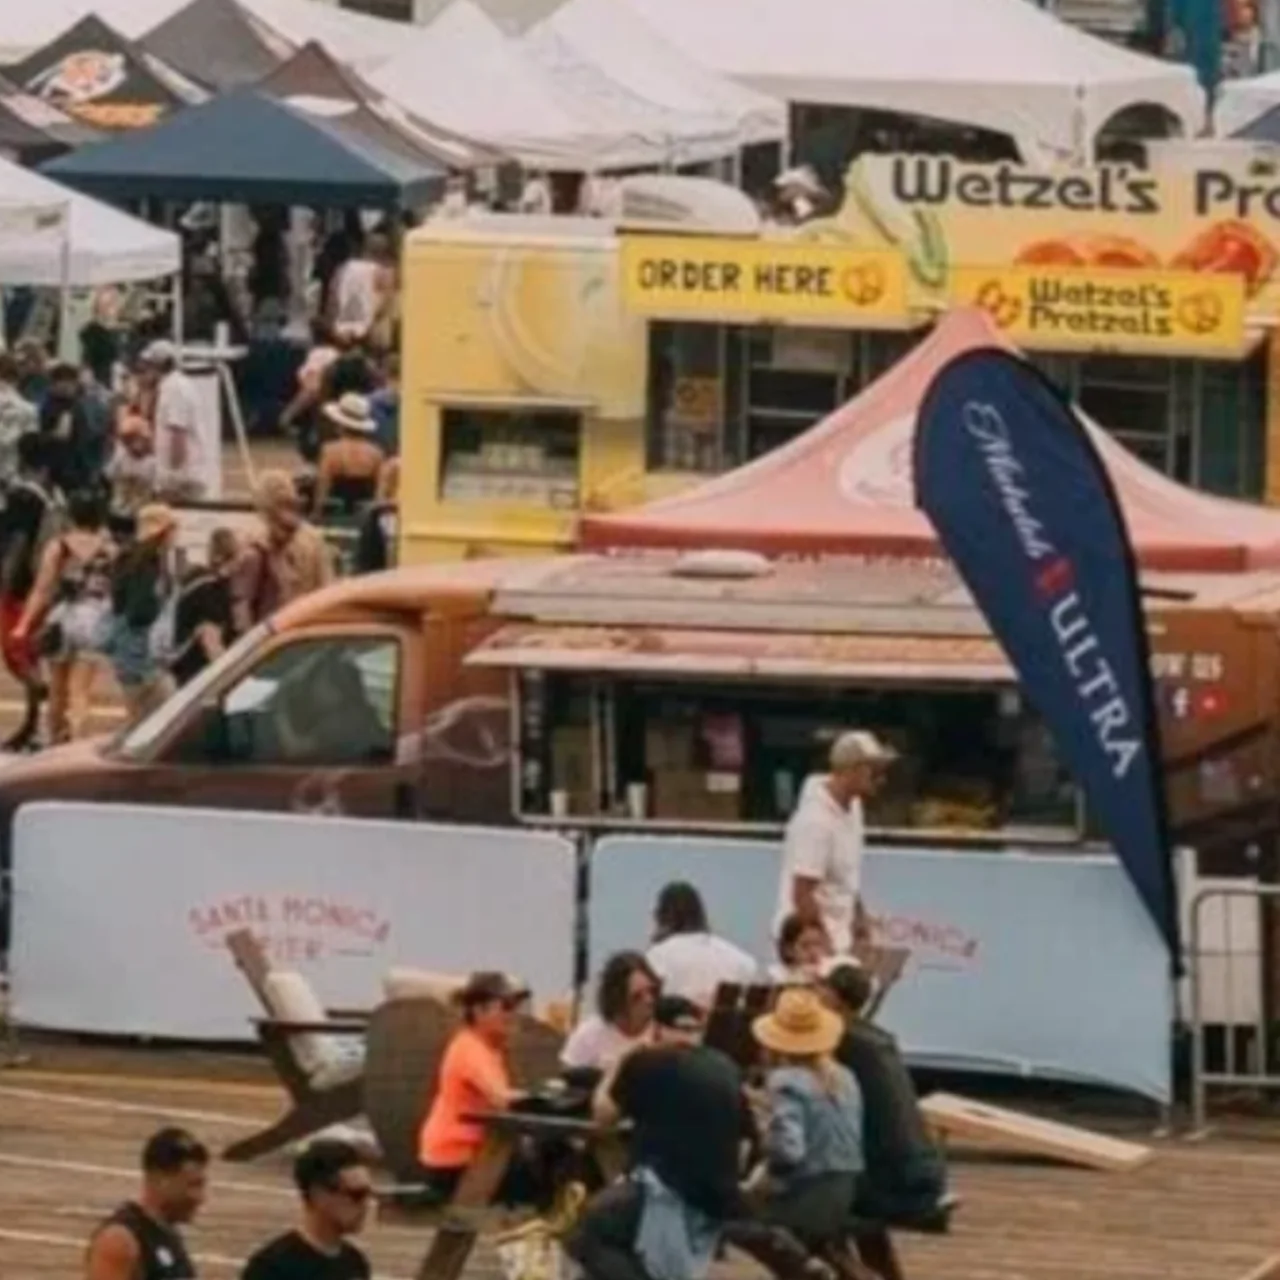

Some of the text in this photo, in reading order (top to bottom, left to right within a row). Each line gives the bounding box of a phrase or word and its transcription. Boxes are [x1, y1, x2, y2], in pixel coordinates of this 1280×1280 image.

[892, 157, 1160, 215] Wetzel's
[639, 259, 833, 296] ORDER HERE
[1028, 277, 1172, 309] Wetzel's
[1028, 303, 1174, 336] Pretzels
[1049, 593, 1140, 778] ULTRA
[188, 896, 391, 943] SANTA MONICA
